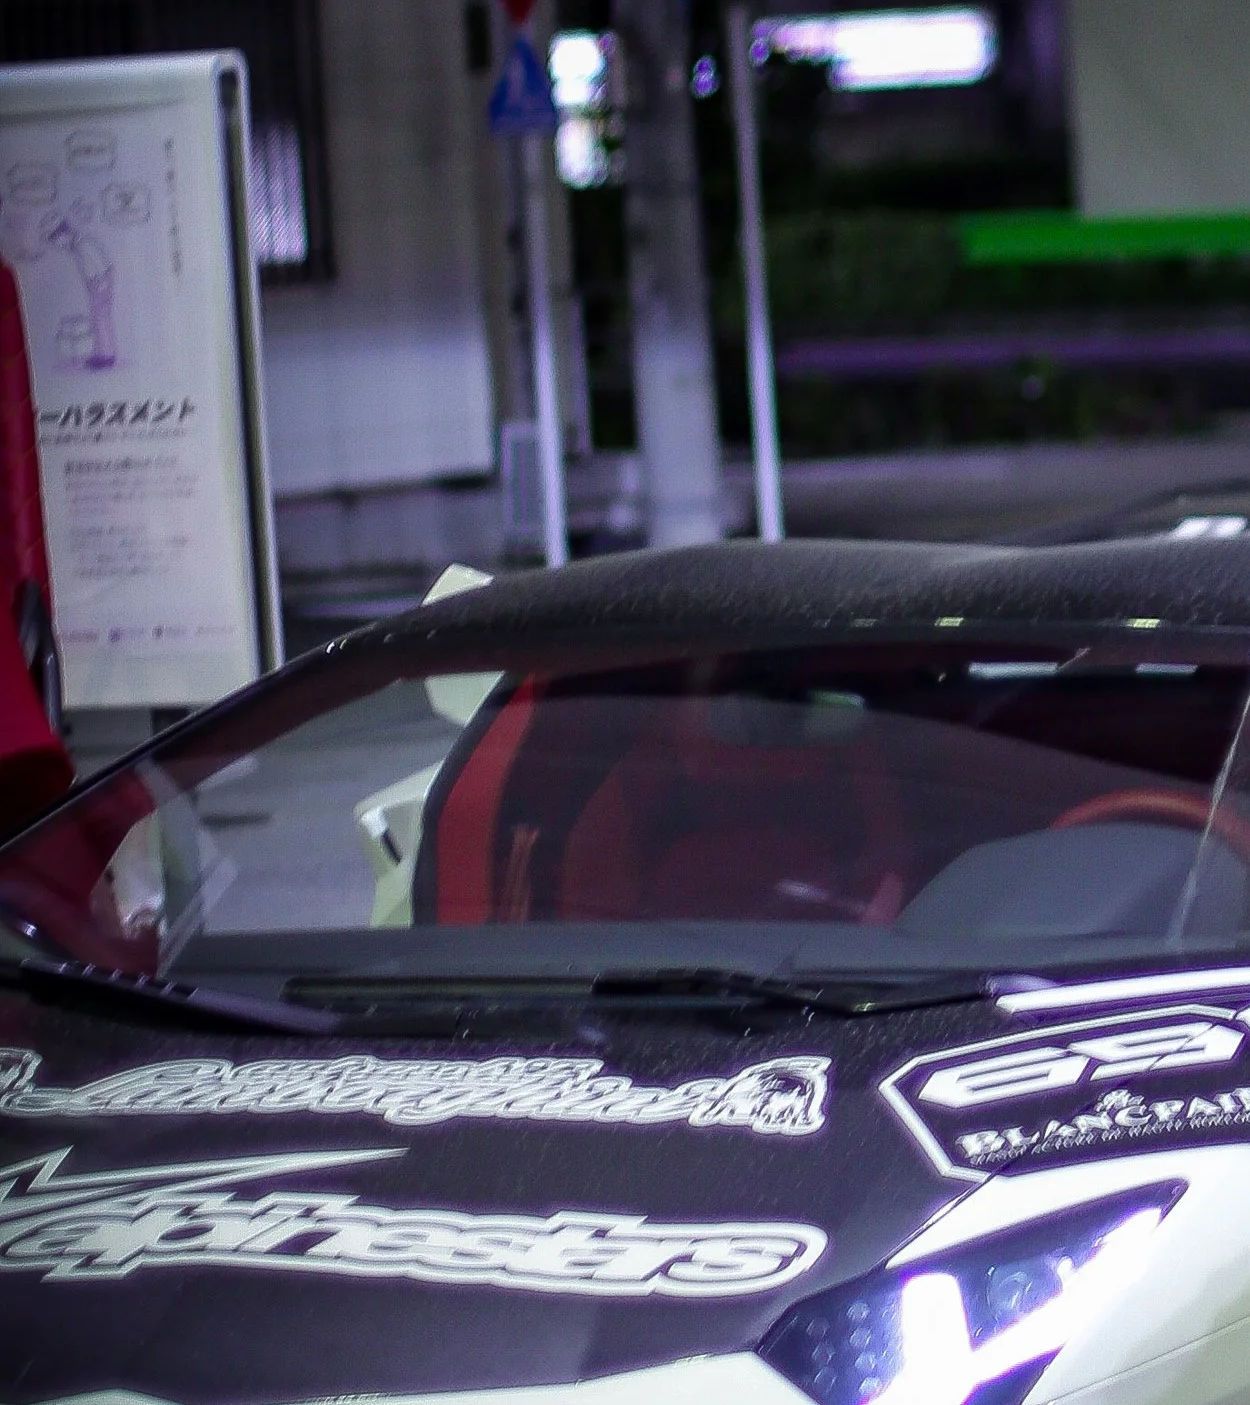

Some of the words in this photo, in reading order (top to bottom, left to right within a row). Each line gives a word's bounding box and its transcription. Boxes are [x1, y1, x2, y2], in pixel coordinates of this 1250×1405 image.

[36, 396, 197, 429] ーハラスメント
